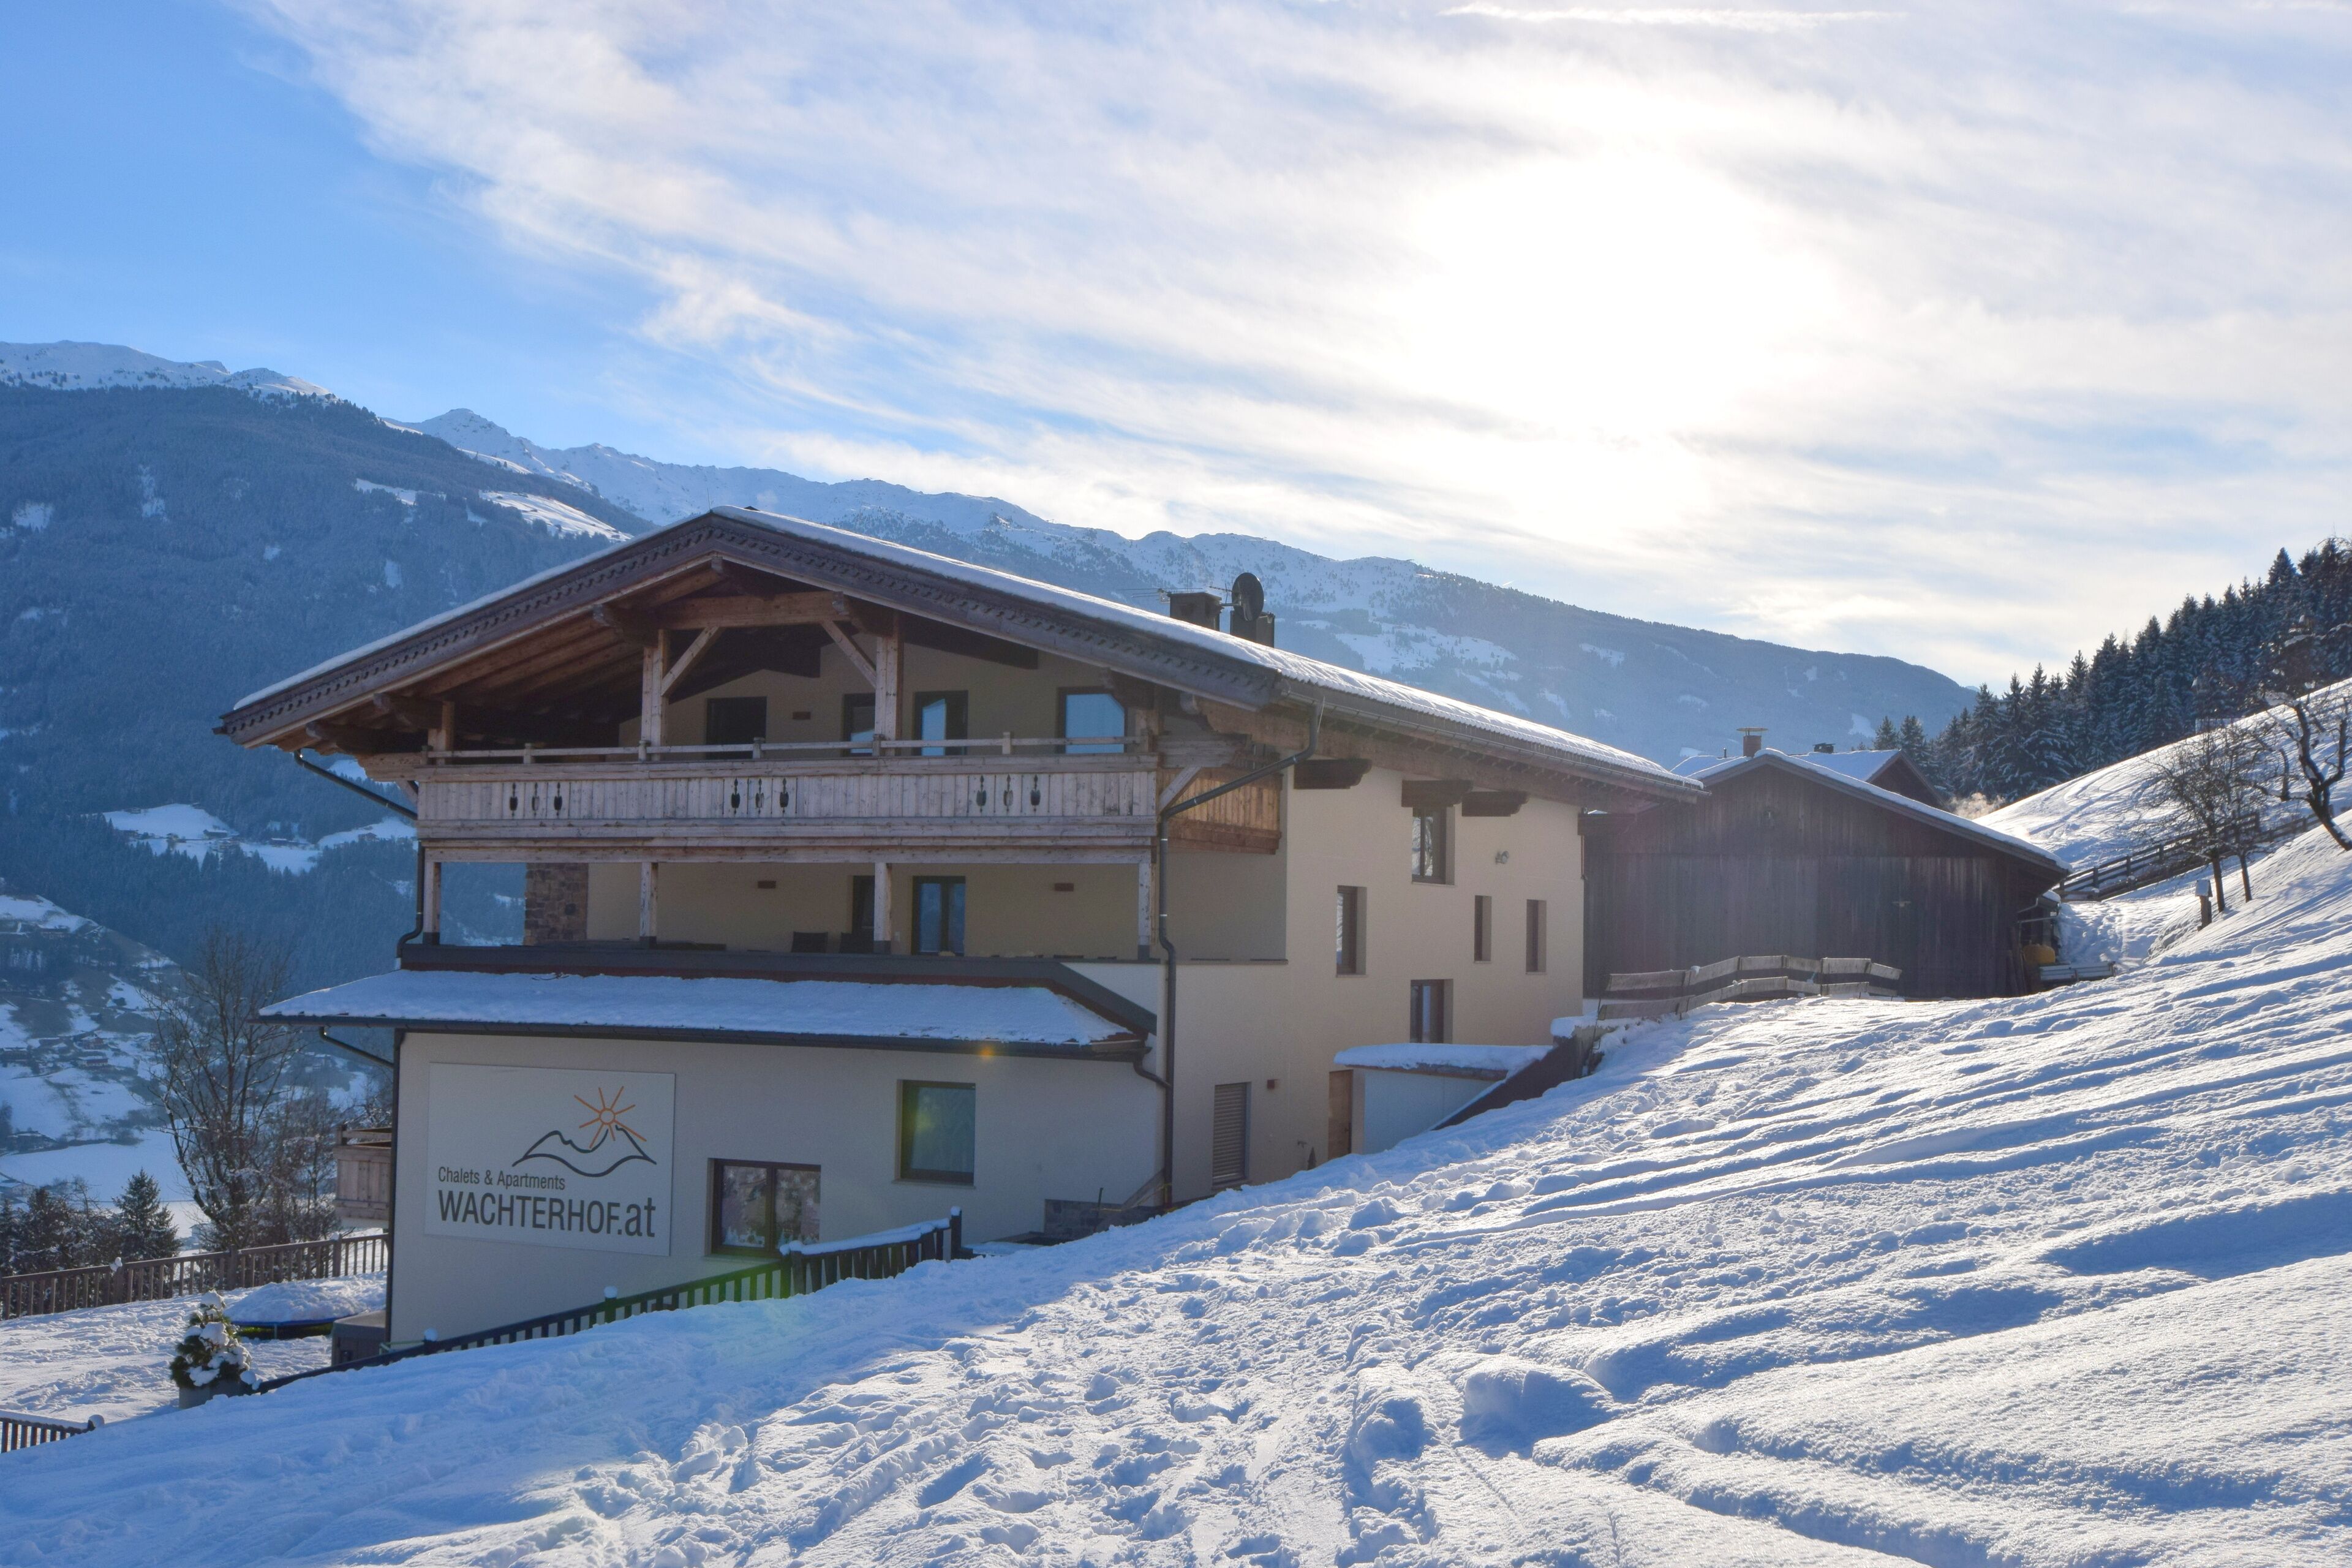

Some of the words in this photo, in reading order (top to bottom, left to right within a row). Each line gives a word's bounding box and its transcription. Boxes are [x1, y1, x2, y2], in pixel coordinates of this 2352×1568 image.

[438, 1166, 480, 1185] Chalets
[484, 1170, 493, 1185] &
[497, 1170, 566, 1191] Apartments
[438, 1190, 656, 1237] WACHTERHOF.at
